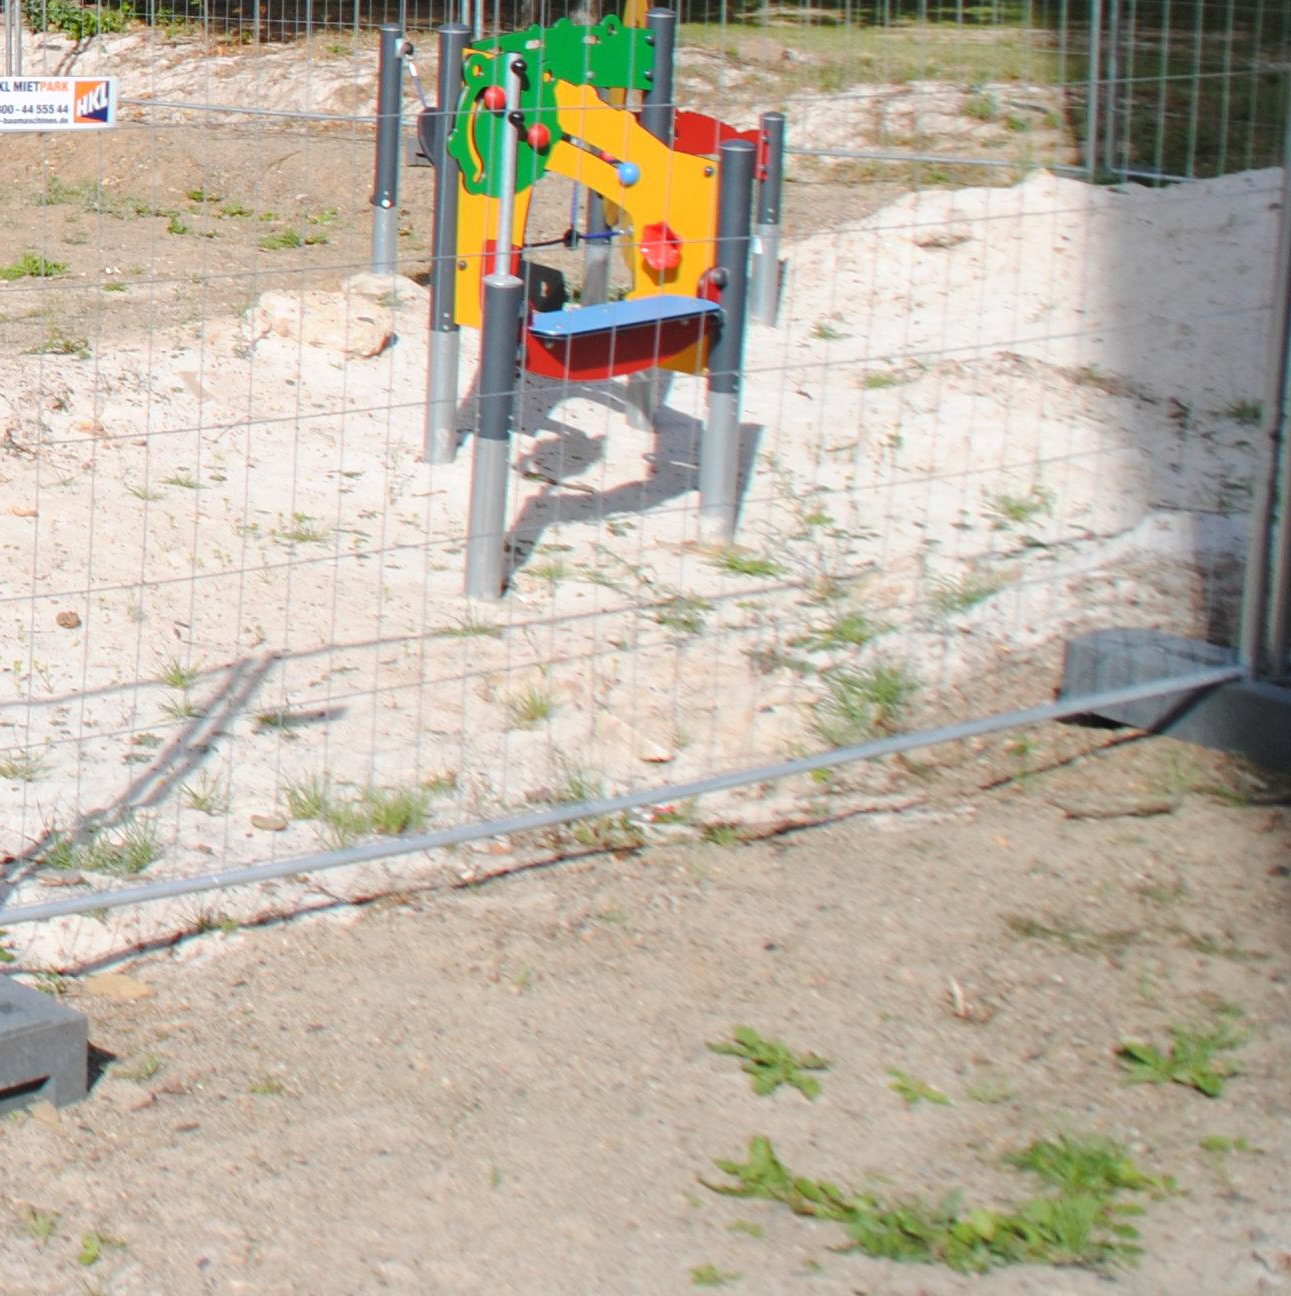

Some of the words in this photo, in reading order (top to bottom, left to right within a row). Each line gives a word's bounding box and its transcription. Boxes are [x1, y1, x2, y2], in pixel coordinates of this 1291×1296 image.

[13, 81, 68, 92] MIETPARK
[76, 81, 107, 117] HKL
[21, 105, 33, 114] 44
[36, 104, 54, 114] 555
[57, 104, 68, 114] 44
